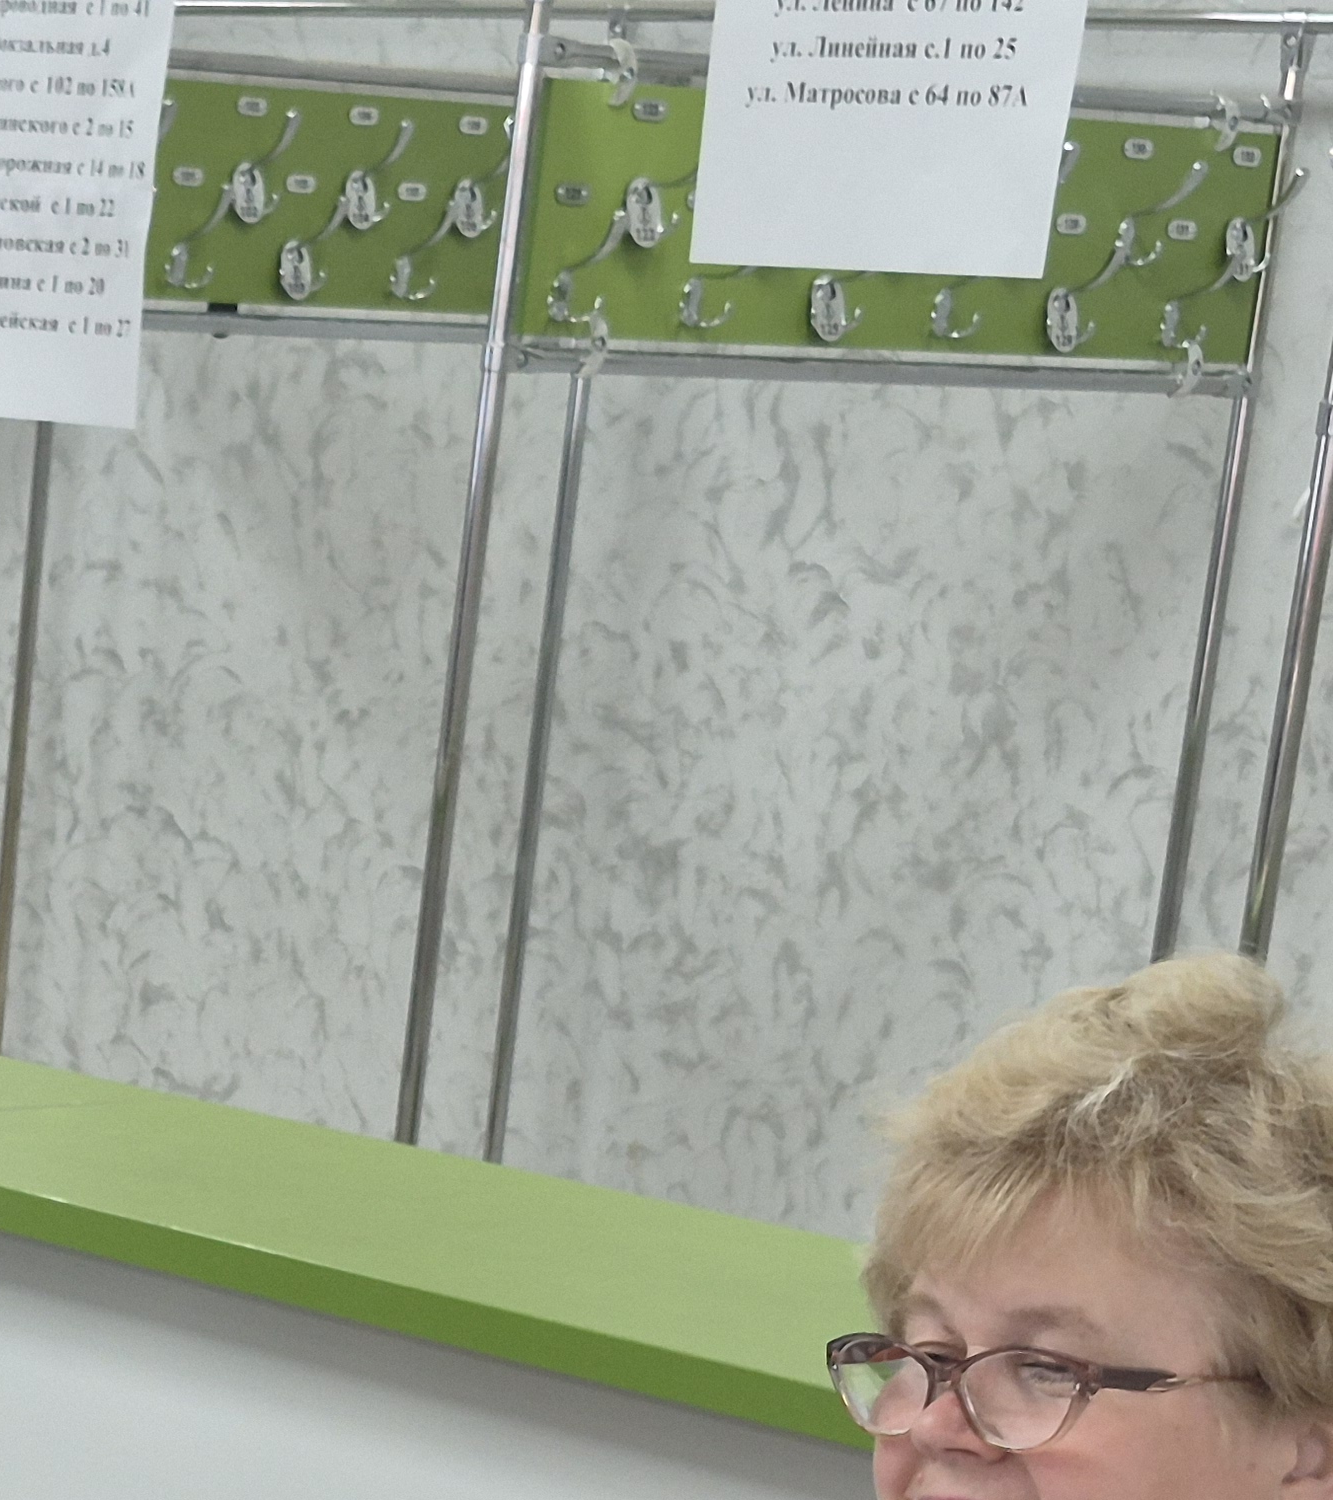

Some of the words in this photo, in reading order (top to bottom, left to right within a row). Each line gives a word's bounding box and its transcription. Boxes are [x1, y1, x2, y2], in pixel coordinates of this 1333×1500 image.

[955, 0, 982, 12] по
[769, 41, 802, 64] ул.
[808, 35, 917, 59] Линейная
[960, 41, 986, 60] по
[992, 36, 1017, 61] 25
[30, 79, 38, 94] с
[47, 76, 72, 96] 102
[77, 82, 95, 96] по
[744, 86, 777, 109] ул.
[784, 81, 901, 111] Матросова
[908, 89, 920, 106] с
[925, 83, 949, 107] 64
[956, 89, 982, 107] по
[988, 84, 1028, 108] 87А
[72, 121, 80, 136] с
[86, 117, 93, 136] 2
[77, 161, 84, 176] с
[51, 200, 59, 215] с
[76, 202, 95, 217] по
[69, 240, 77, 255] с
[81, 236, 89, 257] 2
[94, 242, 111, 257] по
[36, 277, 45, 292] с
[51, 275, 59, 293] 1
[64, 279, 83, 295] по
[88, 276, 105, 296] 20
[68, 319, 76, 334] с
[95, 321, 113, 336] по
